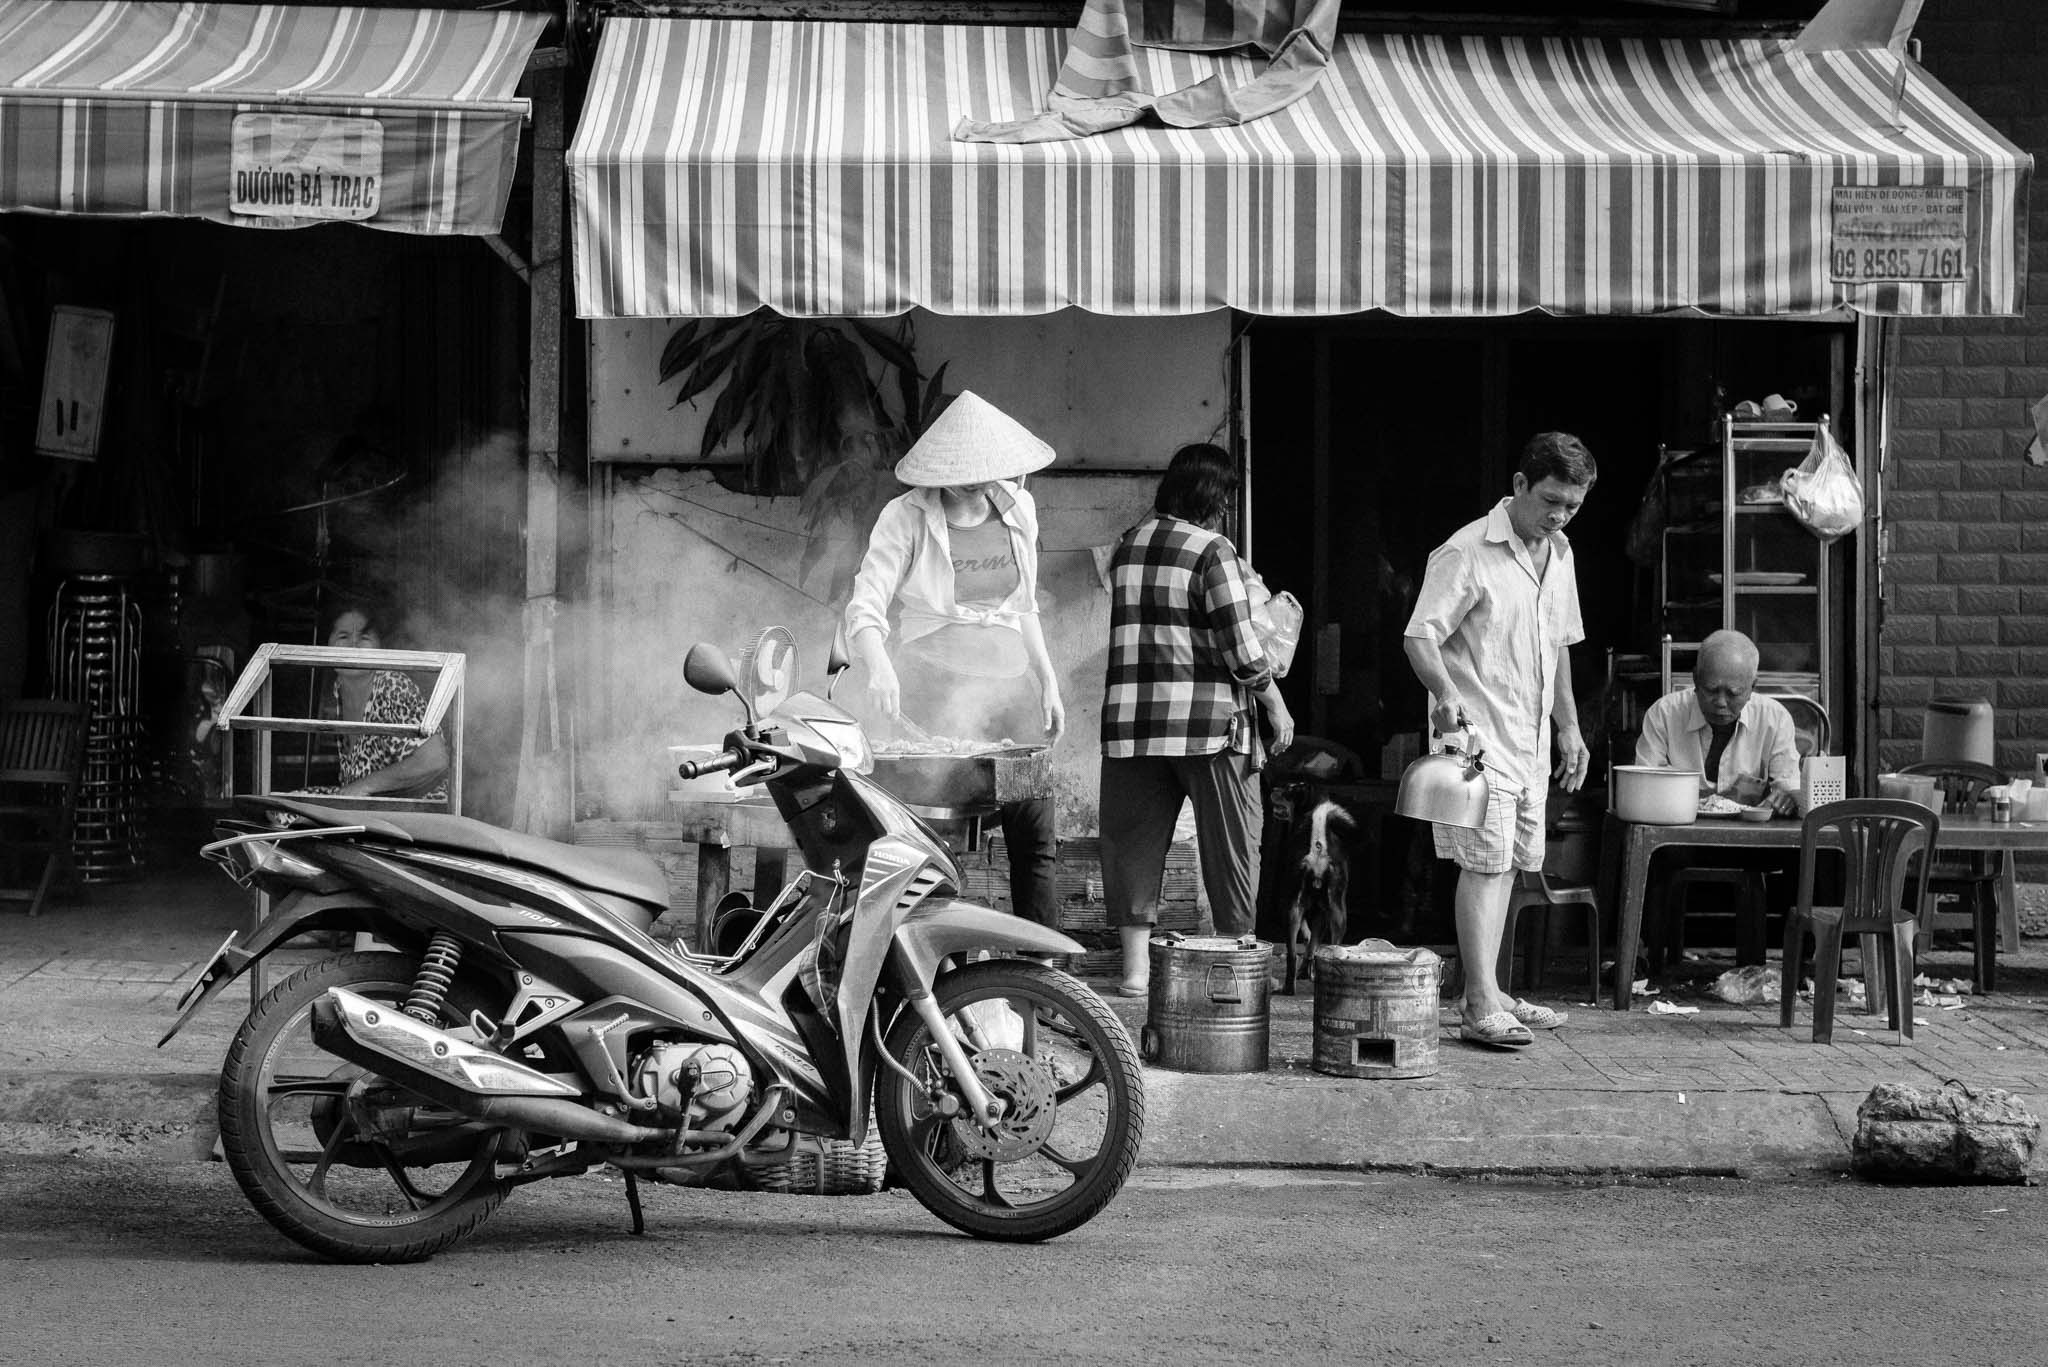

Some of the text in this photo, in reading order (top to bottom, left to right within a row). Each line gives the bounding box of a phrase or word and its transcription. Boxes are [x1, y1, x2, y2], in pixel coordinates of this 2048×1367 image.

[300, 166, 322, 207] BÁ
[331, 175, 375, 216] TRẠC
[1834, 248, 1963, 279] 09 8585 7161
